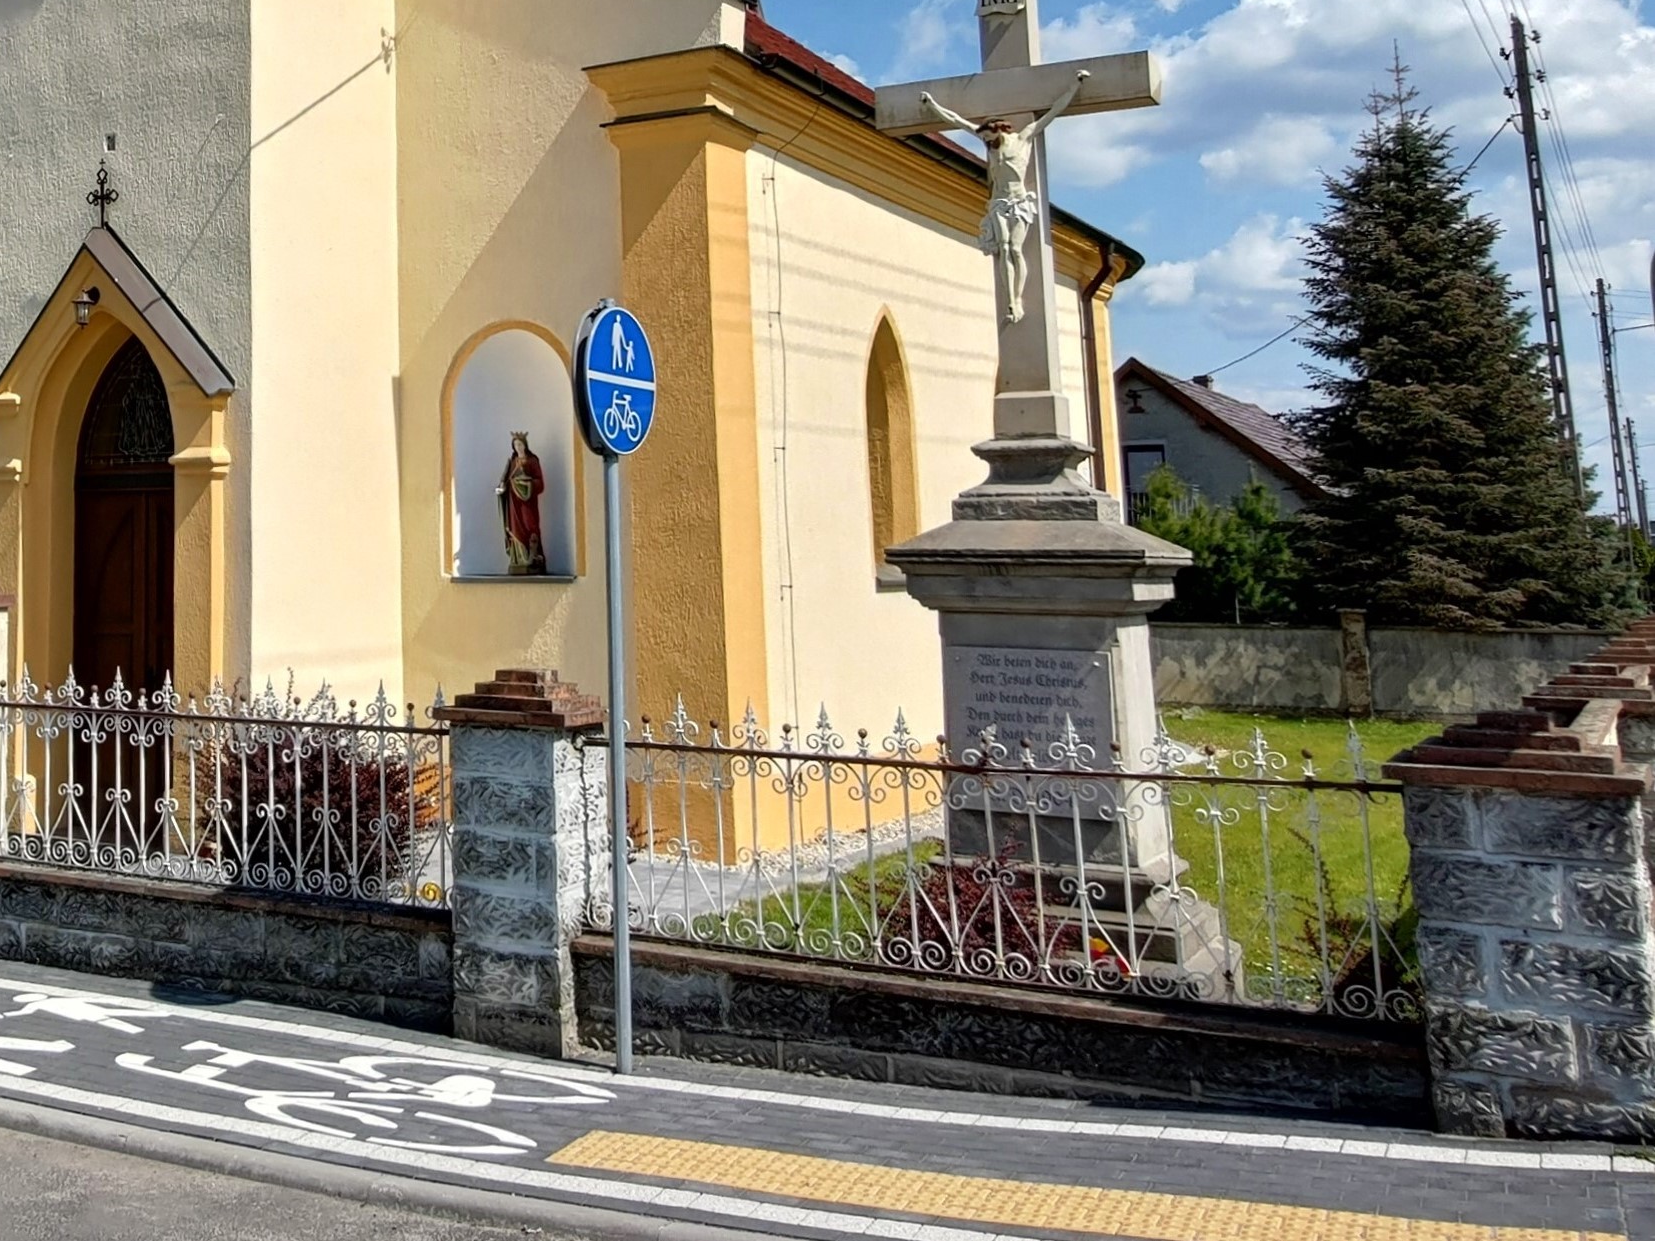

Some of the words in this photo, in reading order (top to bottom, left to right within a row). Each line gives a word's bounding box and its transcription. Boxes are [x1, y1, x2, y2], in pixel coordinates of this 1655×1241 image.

[976, 654, 1001, 667] Wir
[1004, 655, 1031, 668] beten
[1035, 657, 1057, 671] dich
[970, 671, 995, 685] Herr
[998, 671, 1032, 686] Jesus
[975, 692, 996, 703] und
[999, 692, 1052, 706] benedeien
[993, 710, 1023, 724] durch
